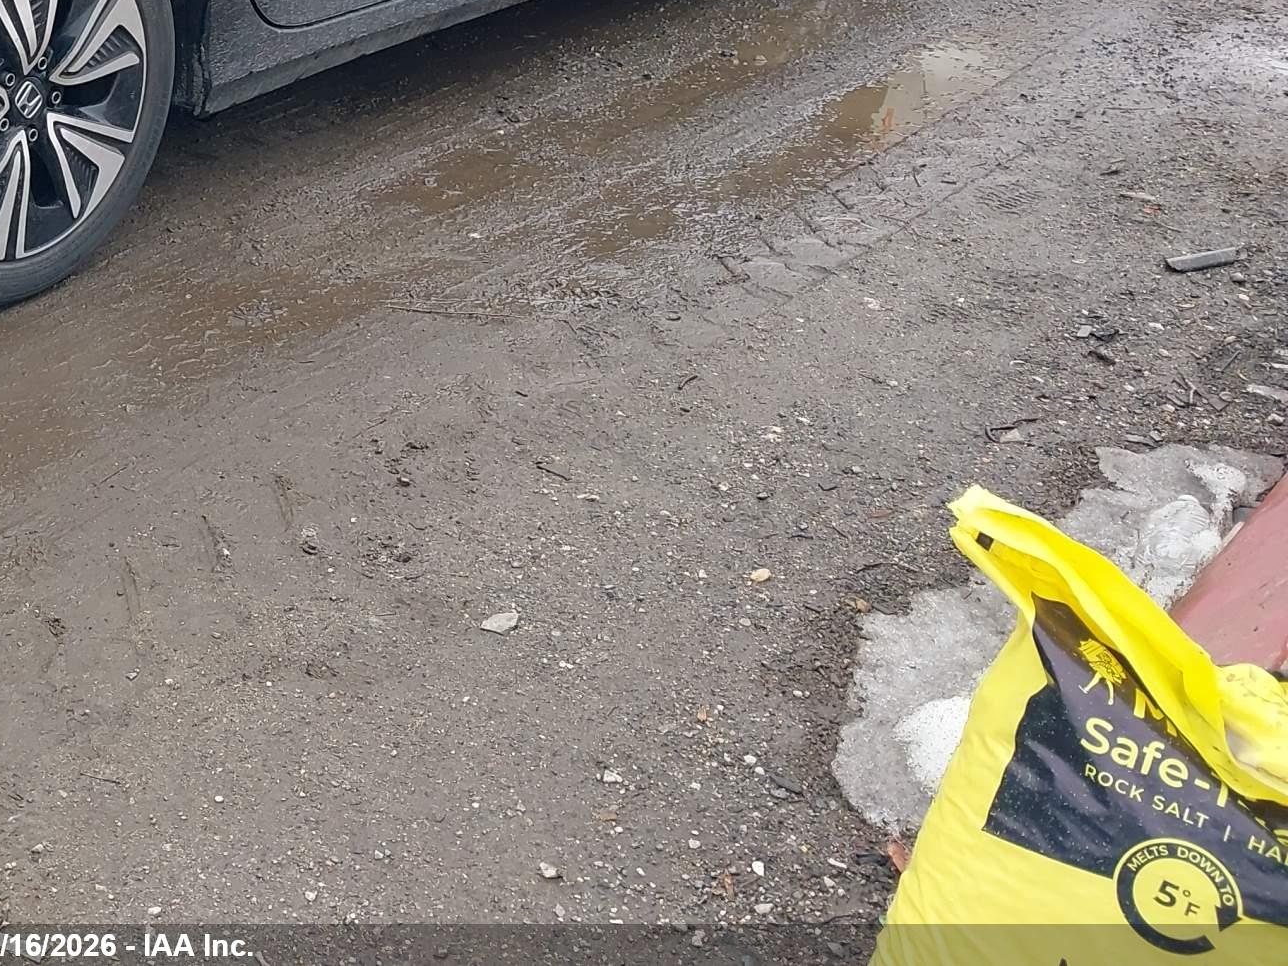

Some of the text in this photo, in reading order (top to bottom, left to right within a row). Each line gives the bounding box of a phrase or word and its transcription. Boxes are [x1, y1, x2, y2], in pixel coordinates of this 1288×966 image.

[1085, 764, 1145, 802] ROCK
[1152, 795, 1209, 828] SALT
[1127, 845, 1235, 907] MELTS DOWN TO
